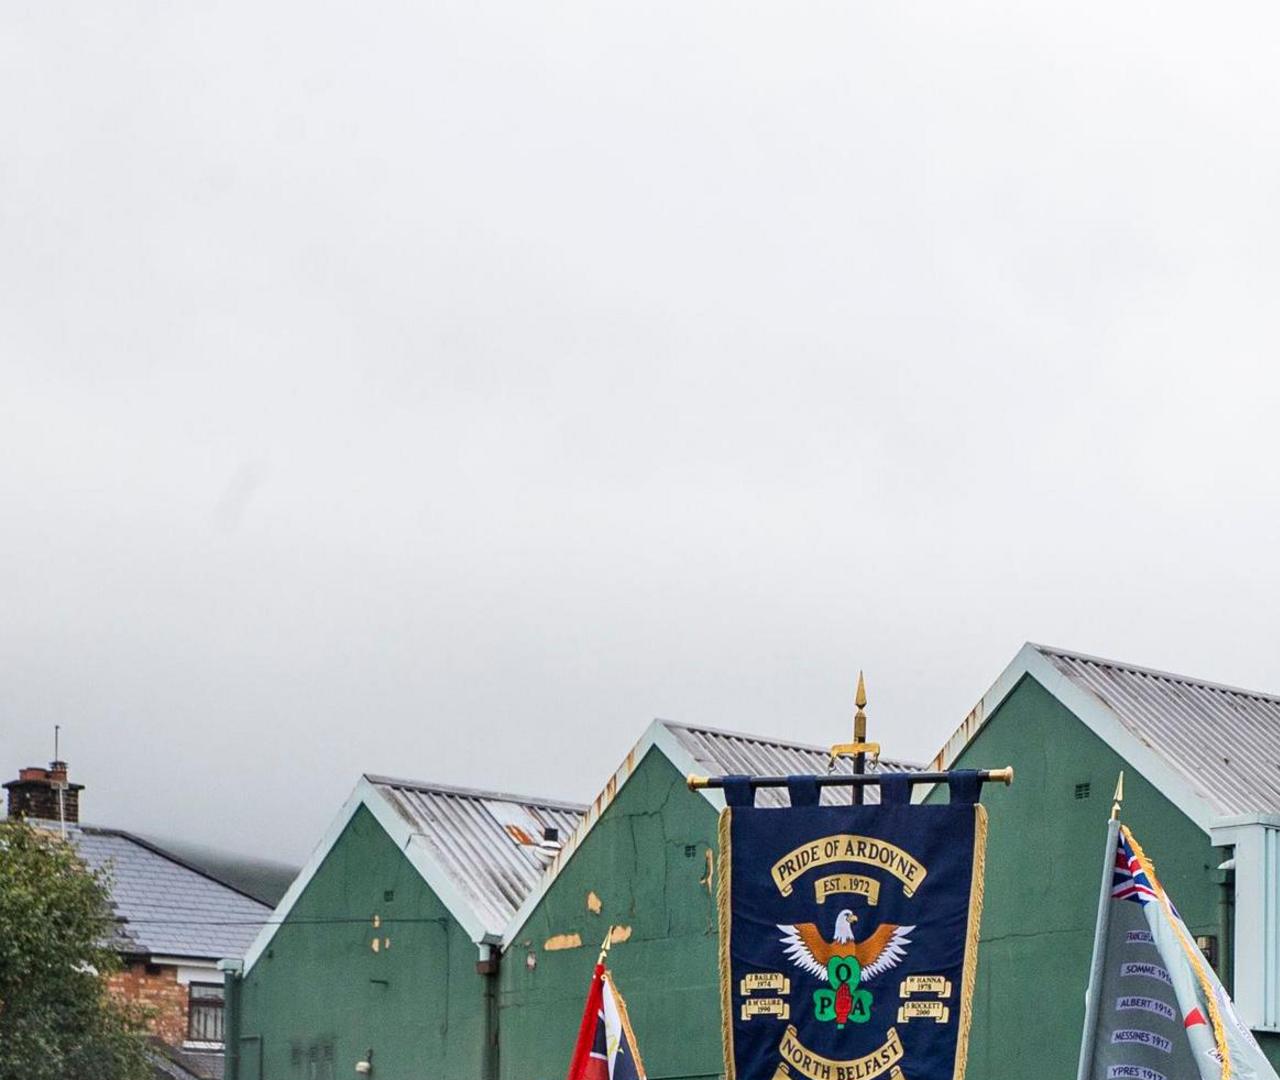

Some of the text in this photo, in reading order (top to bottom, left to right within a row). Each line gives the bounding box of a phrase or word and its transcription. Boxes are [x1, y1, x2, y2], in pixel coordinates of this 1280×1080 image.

[778, 839, 918, 882] PRIDE OF ARDOYNE
[849, 878, 870, 893] 1972
[834, 963, 852, 983] O
[1125, 964, 1156, 975] SOMME
[820, 996, 866, 1016] P A
[1120, 998, 1173, 1017] ALBERT 1916
[1114, 1030, 1150, 1041] MESSINES
[782, 1038, 830, 1080] NORTH
[1112, 1066, 1139, 1077] YPRES
